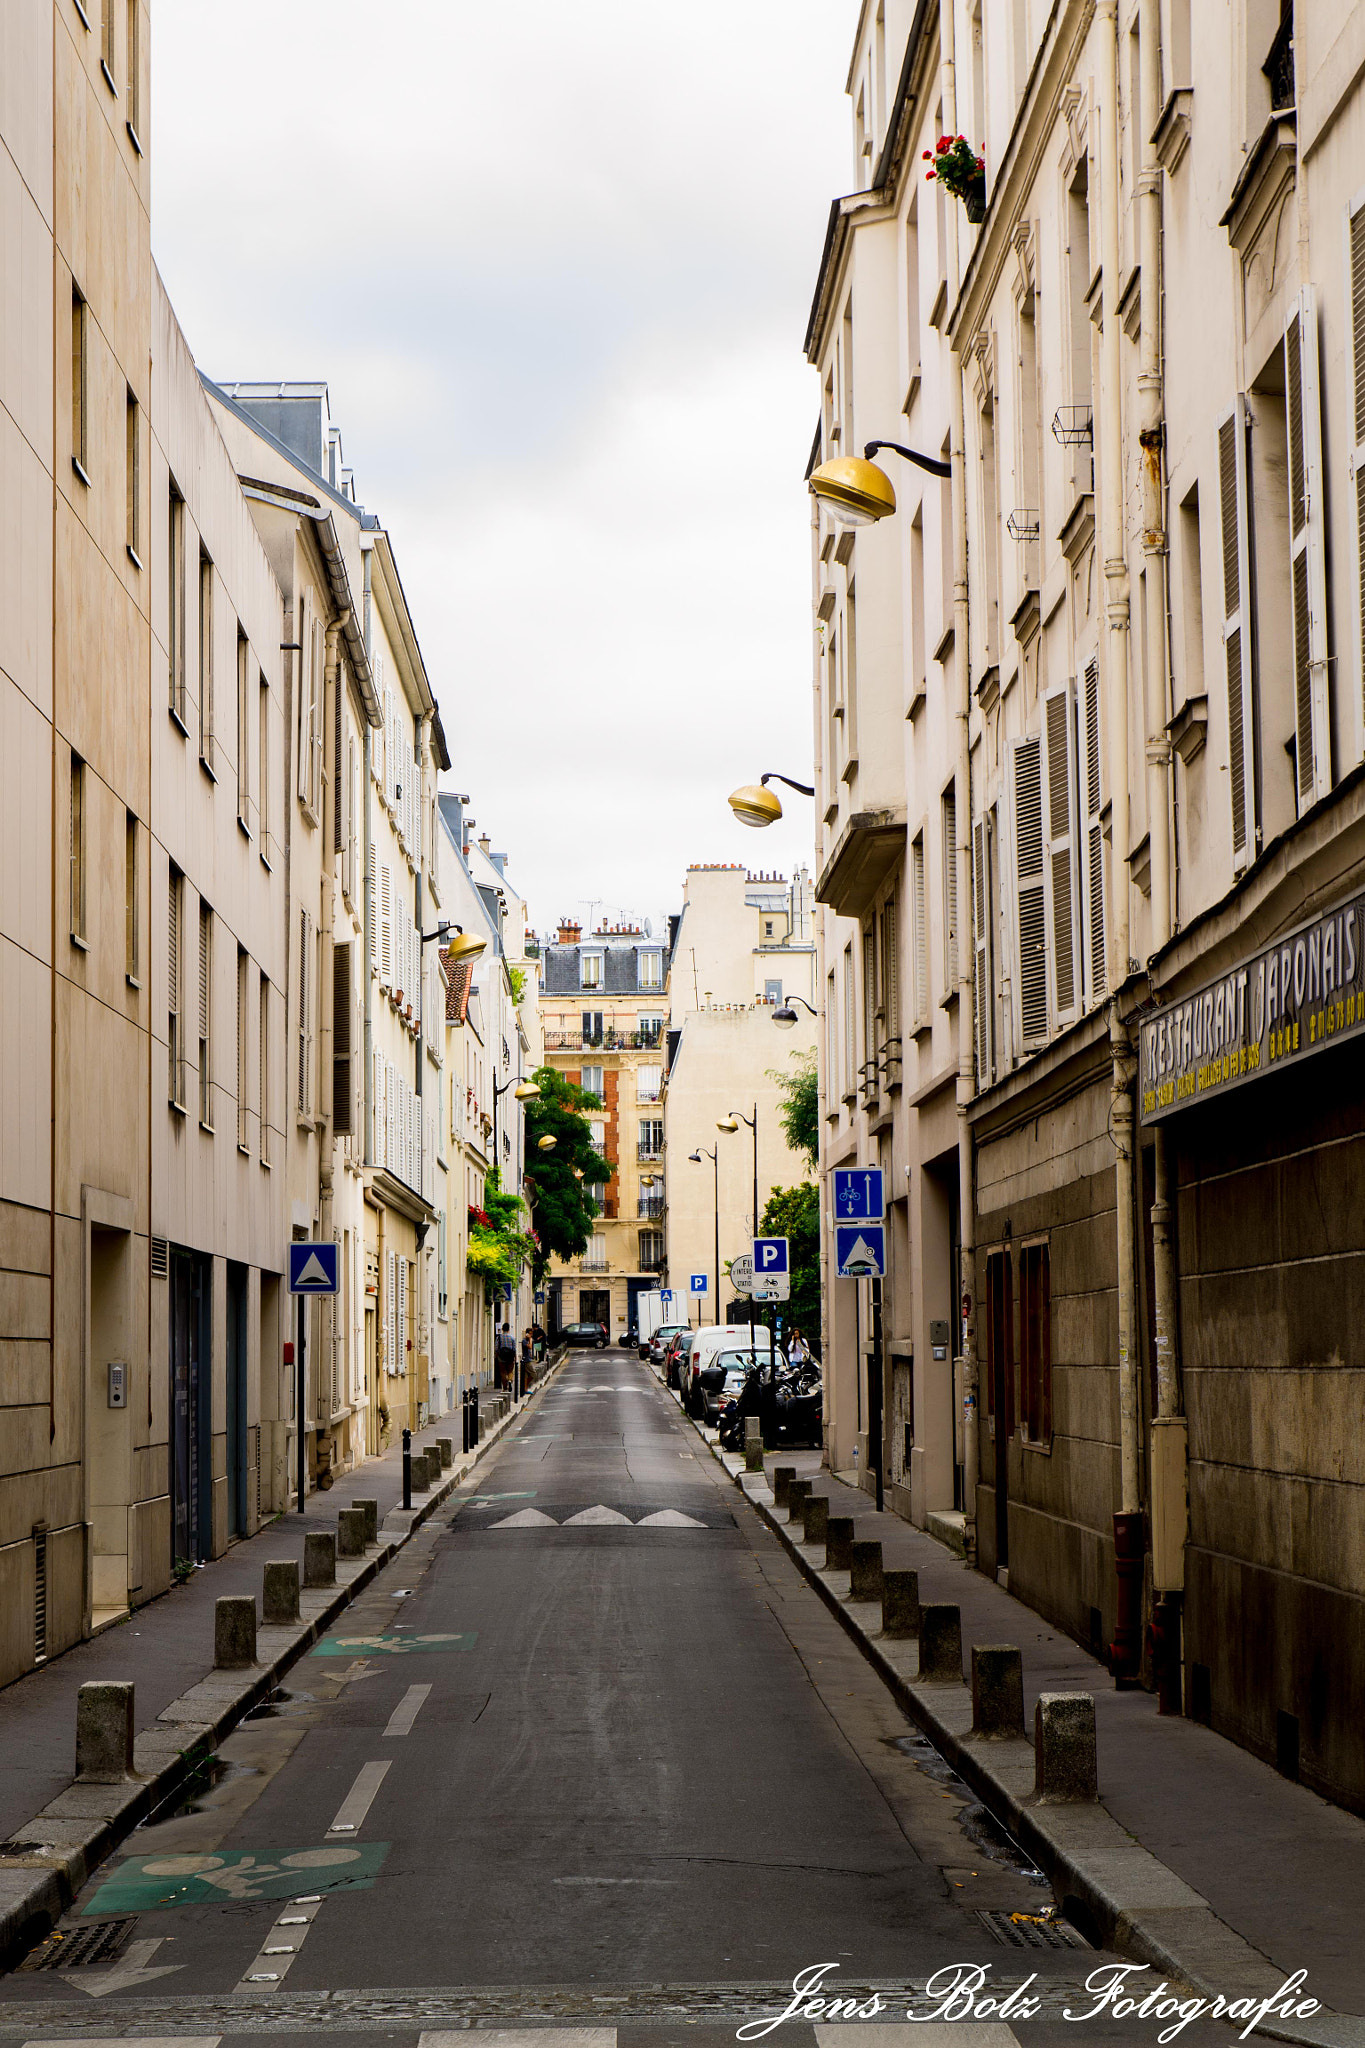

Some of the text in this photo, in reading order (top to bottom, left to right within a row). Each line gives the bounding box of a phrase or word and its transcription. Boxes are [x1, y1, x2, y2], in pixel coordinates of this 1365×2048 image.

[1148, 908, 1357, 1085] RESTAURANT JAPONAIS
[763, 1245, 778, 1267] P
[695, 1277, 703, 1289] P
